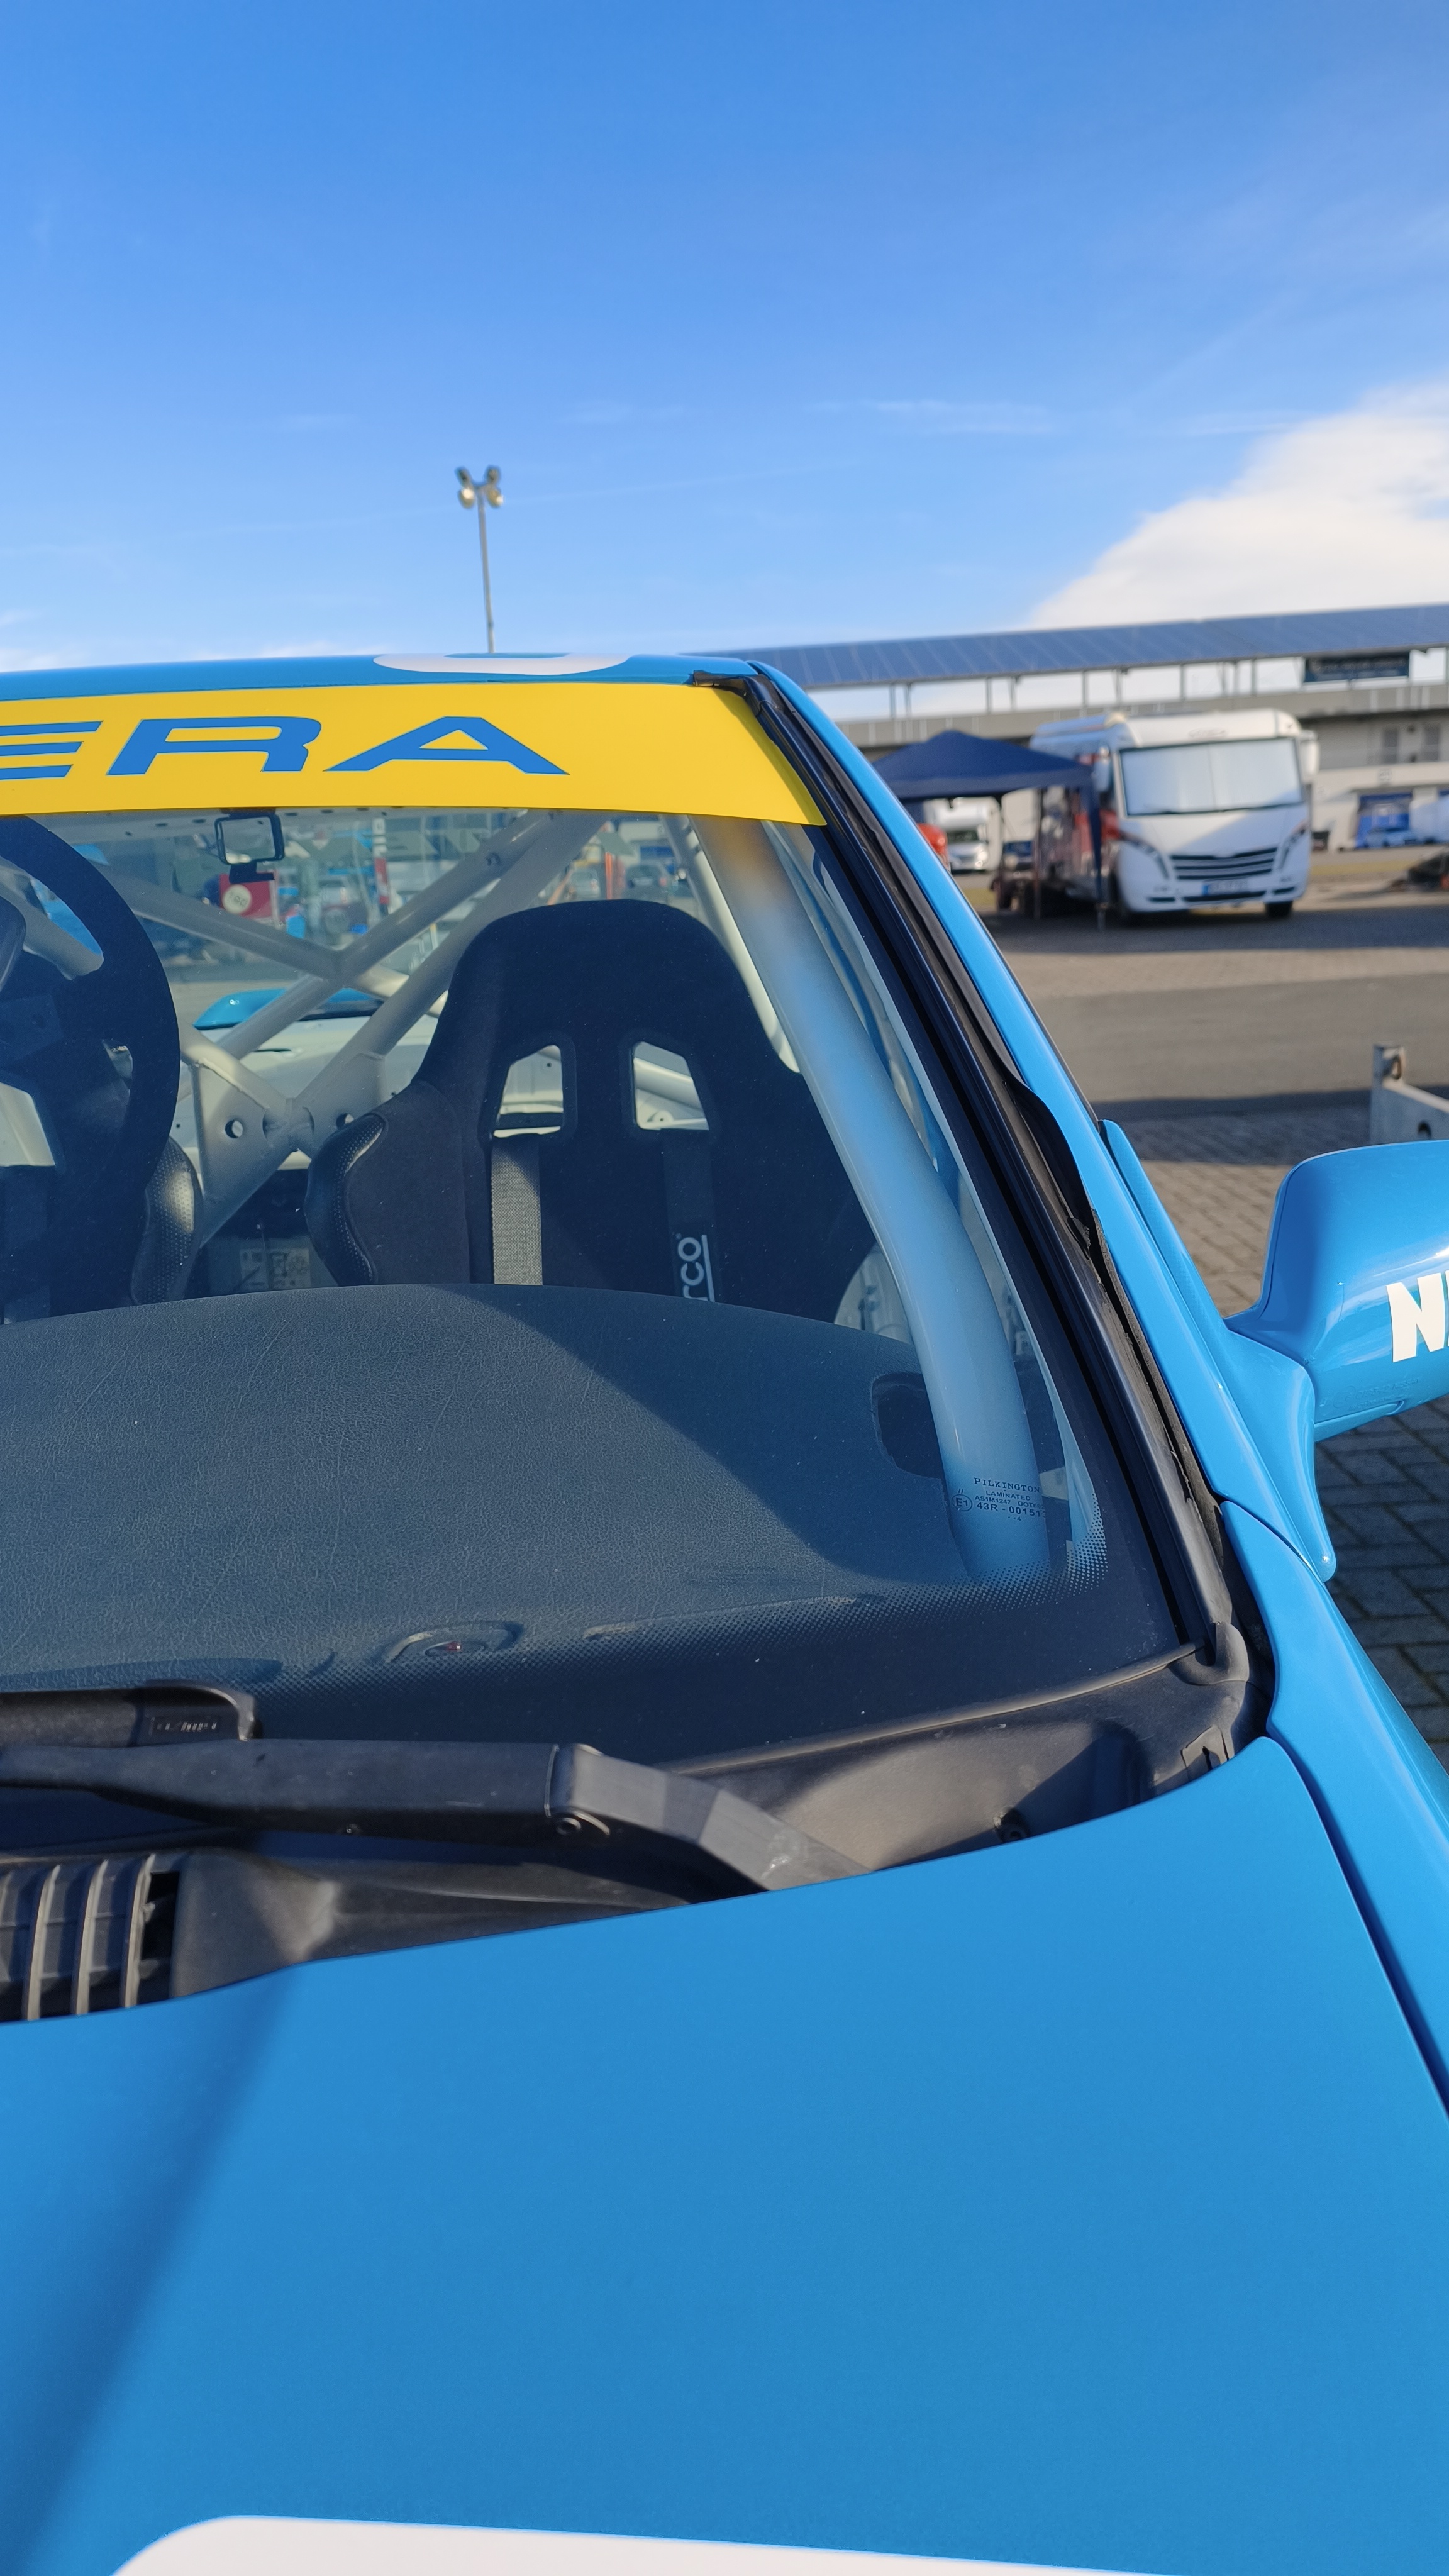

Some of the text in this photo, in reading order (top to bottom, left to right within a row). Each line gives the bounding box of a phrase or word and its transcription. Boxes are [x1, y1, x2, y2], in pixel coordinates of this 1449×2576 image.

[1386, 1270, 1449, 1363] N
[974, 1477, 1040, 1493] PILKINGTON
[985, 1490, 1031, 1501] LAMINATED
[956, 1497, 968, 1507] E1
[976, 1502, 999, 1512] 43R
